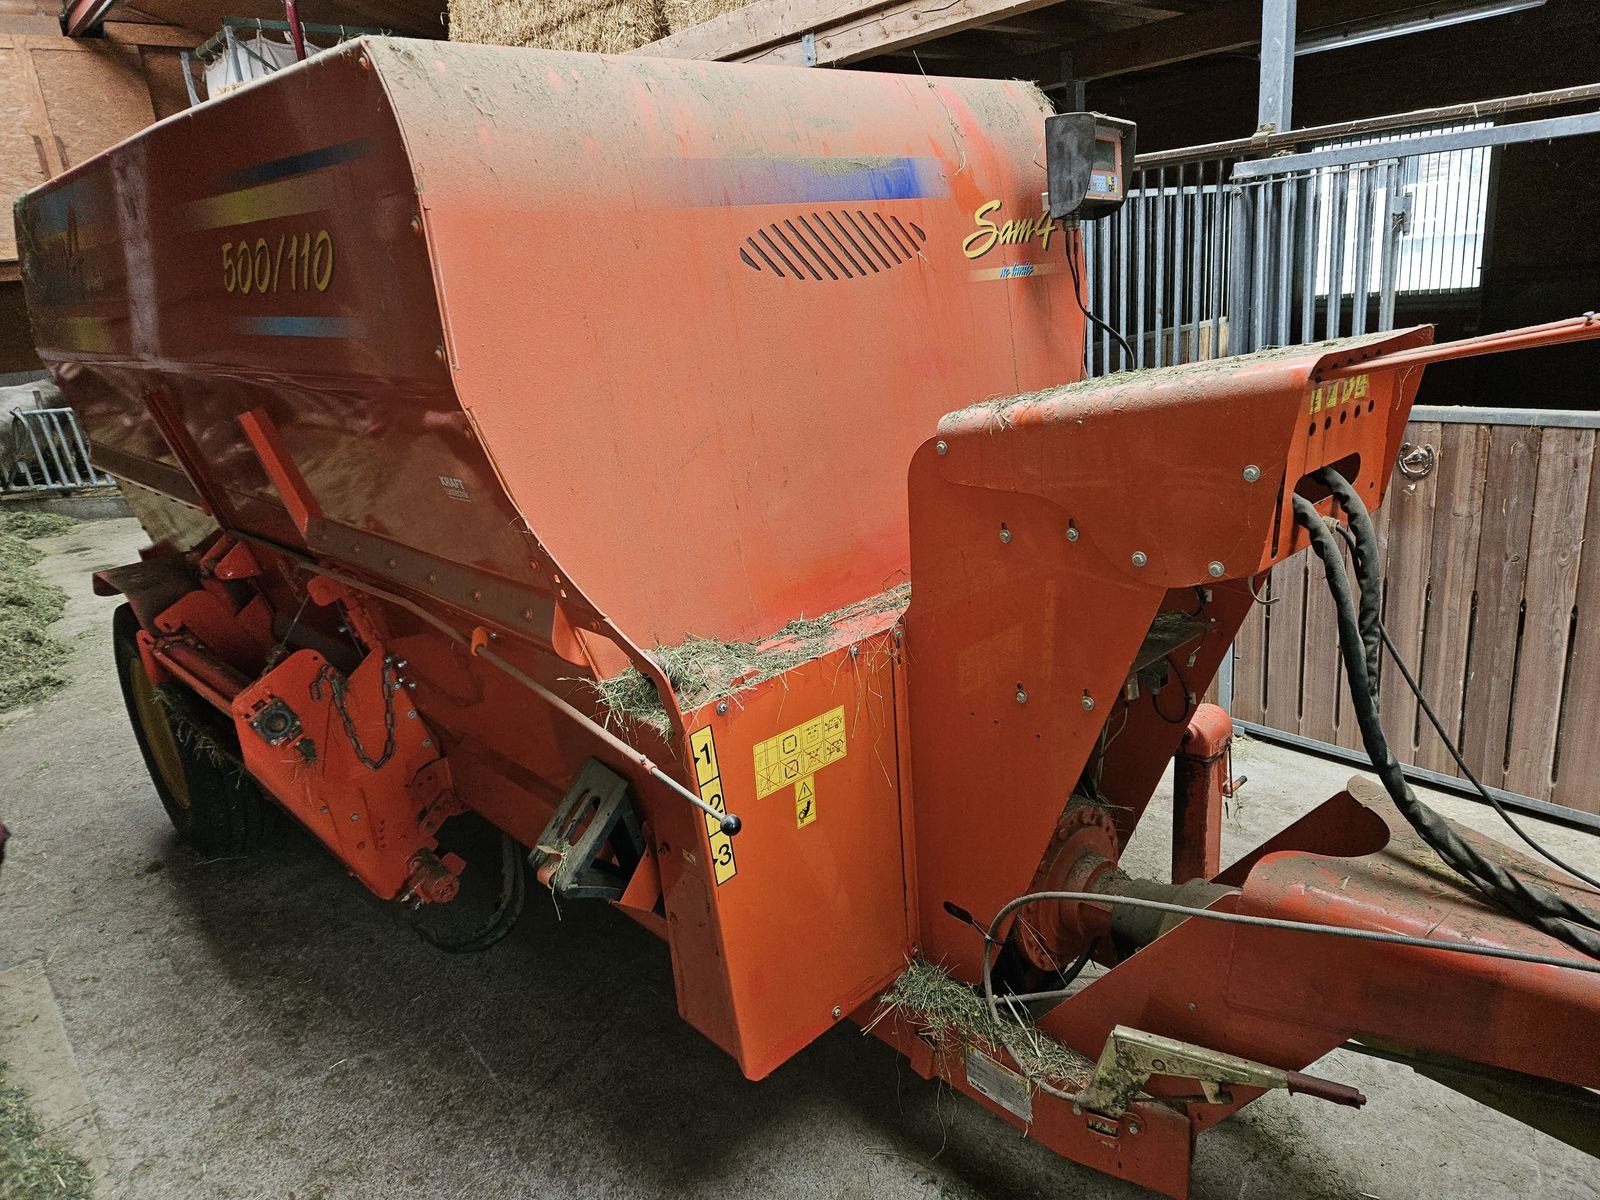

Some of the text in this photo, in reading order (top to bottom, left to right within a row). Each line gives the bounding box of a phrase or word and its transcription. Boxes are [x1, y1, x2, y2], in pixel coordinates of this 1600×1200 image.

[222, 229, 334, 295] 500/110
[700, 743, 711, 765] 1
[718, 843, 732, 866] 3
